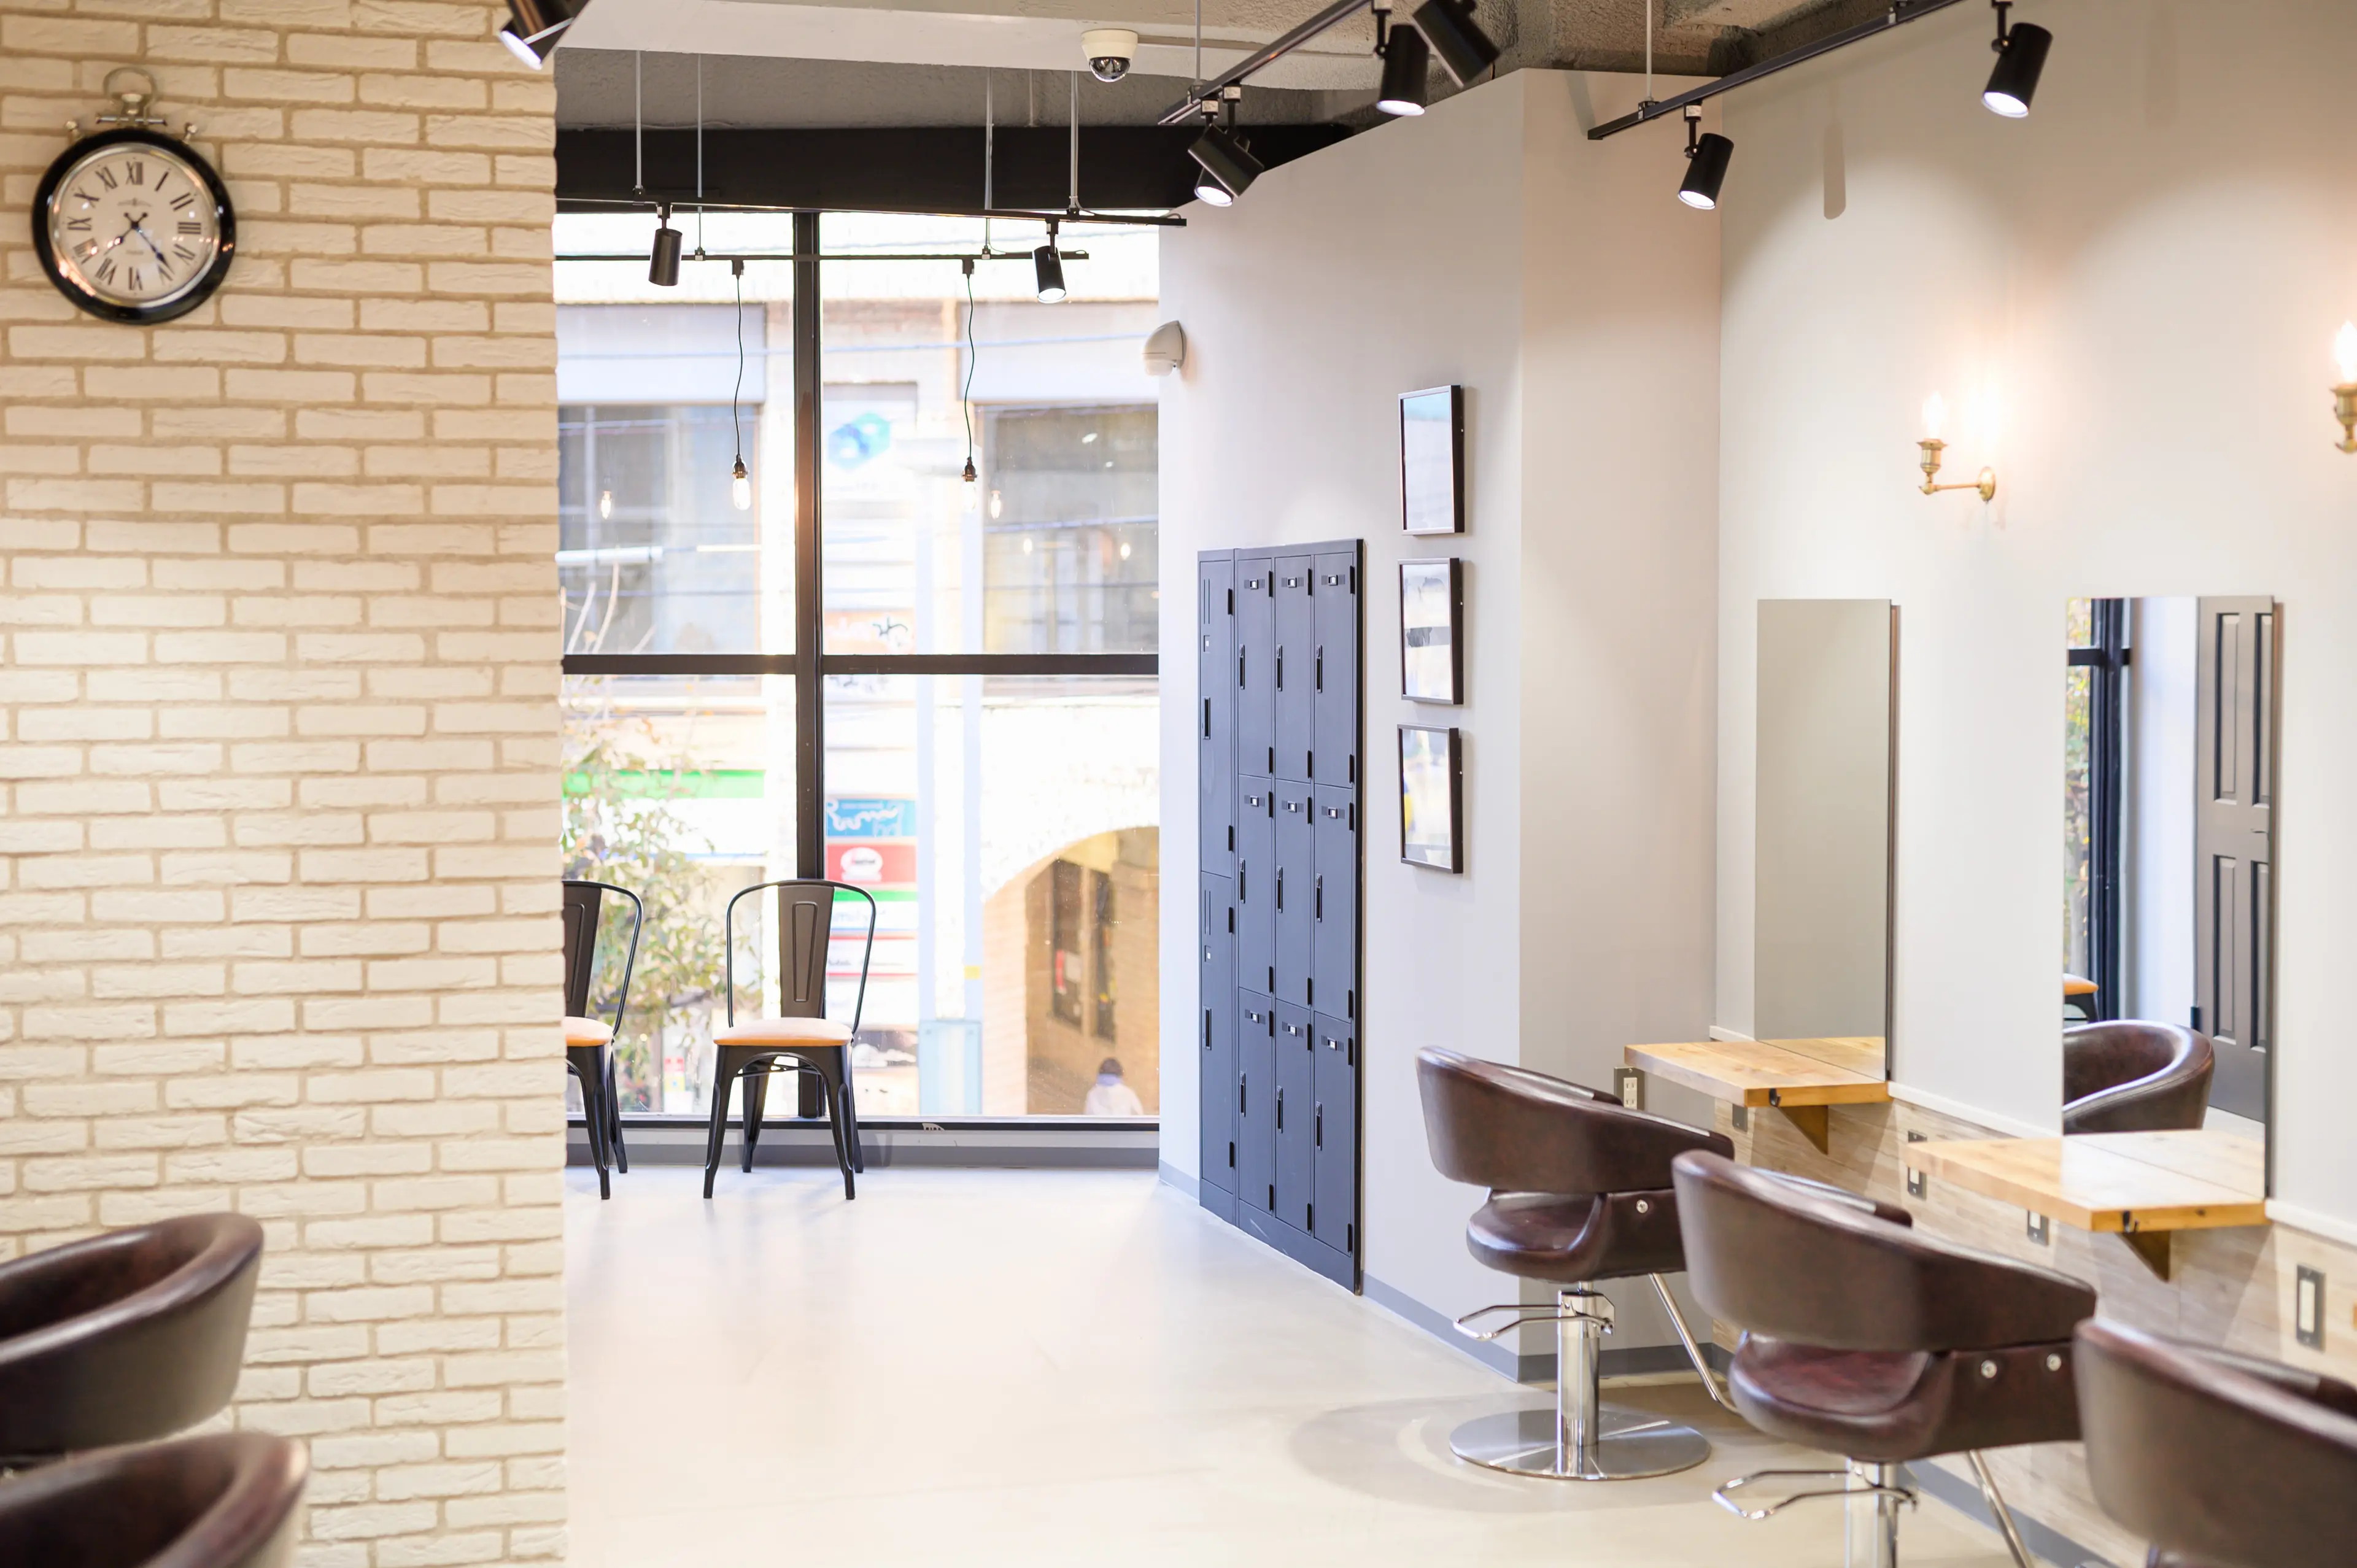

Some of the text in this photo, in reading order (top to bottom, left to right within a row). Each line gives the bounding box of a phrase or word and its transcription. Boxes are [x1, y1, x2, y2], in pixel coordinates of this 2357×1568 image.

[95, 166, 118, 192] XI
[126, 161, 143, 185] XII
[155, 172, 169, 191] I
[74, 187, 99, 207] X
[169, 192, 194, 211] II
[67, 217, 91, 231] IX
[177, 222, 201, 234] III
[172, 244, 195, 265] IV
[95, 258, 117, 285] VII
[128, 266, 143, 291] VI
[158, 264, 173, 285] V
